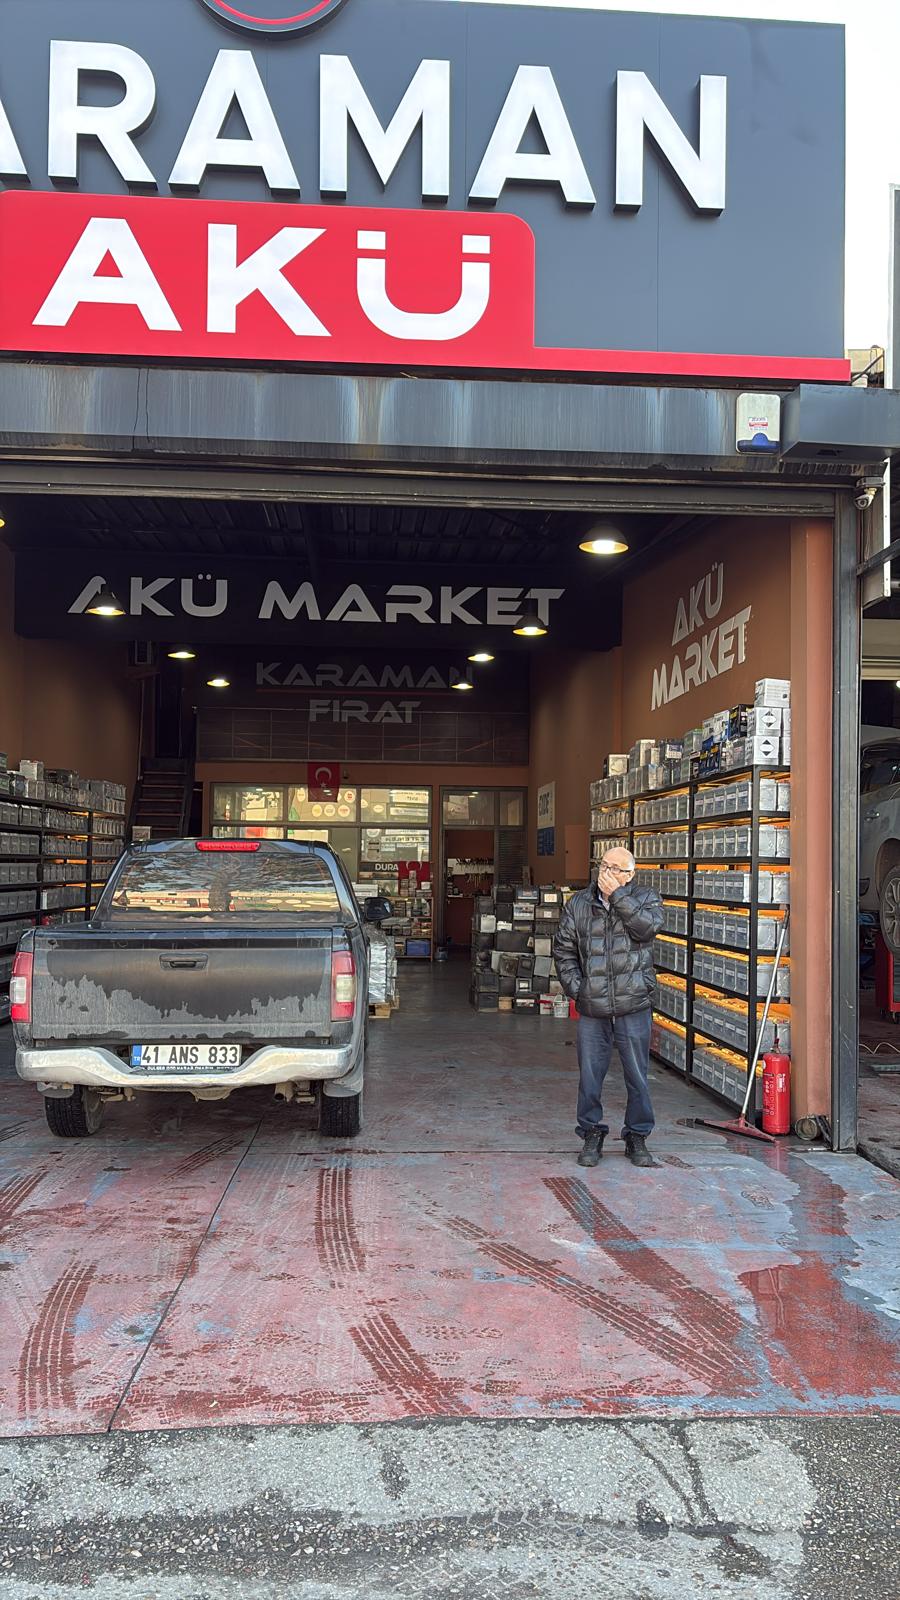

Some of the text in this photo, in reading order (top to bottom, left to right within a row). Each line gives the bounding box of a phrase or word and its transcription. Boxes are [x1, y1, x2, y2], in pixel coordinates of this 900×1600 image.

[0, 39, 728, 212] RAMAN
[32, 216, 492, 341] AKÜ
[67, 573, 566, 626] AKÜ MARKET
[671, 561, 724, 647] AKÜ
[256, 661, 473, 689] KARAMAN
[650, 604, 752, 711] MARKET
[142, 1046, 160, 1064] 41
[168, 1046, 199, 1064] ANS
[208, 1046, 238, 1064] 833
